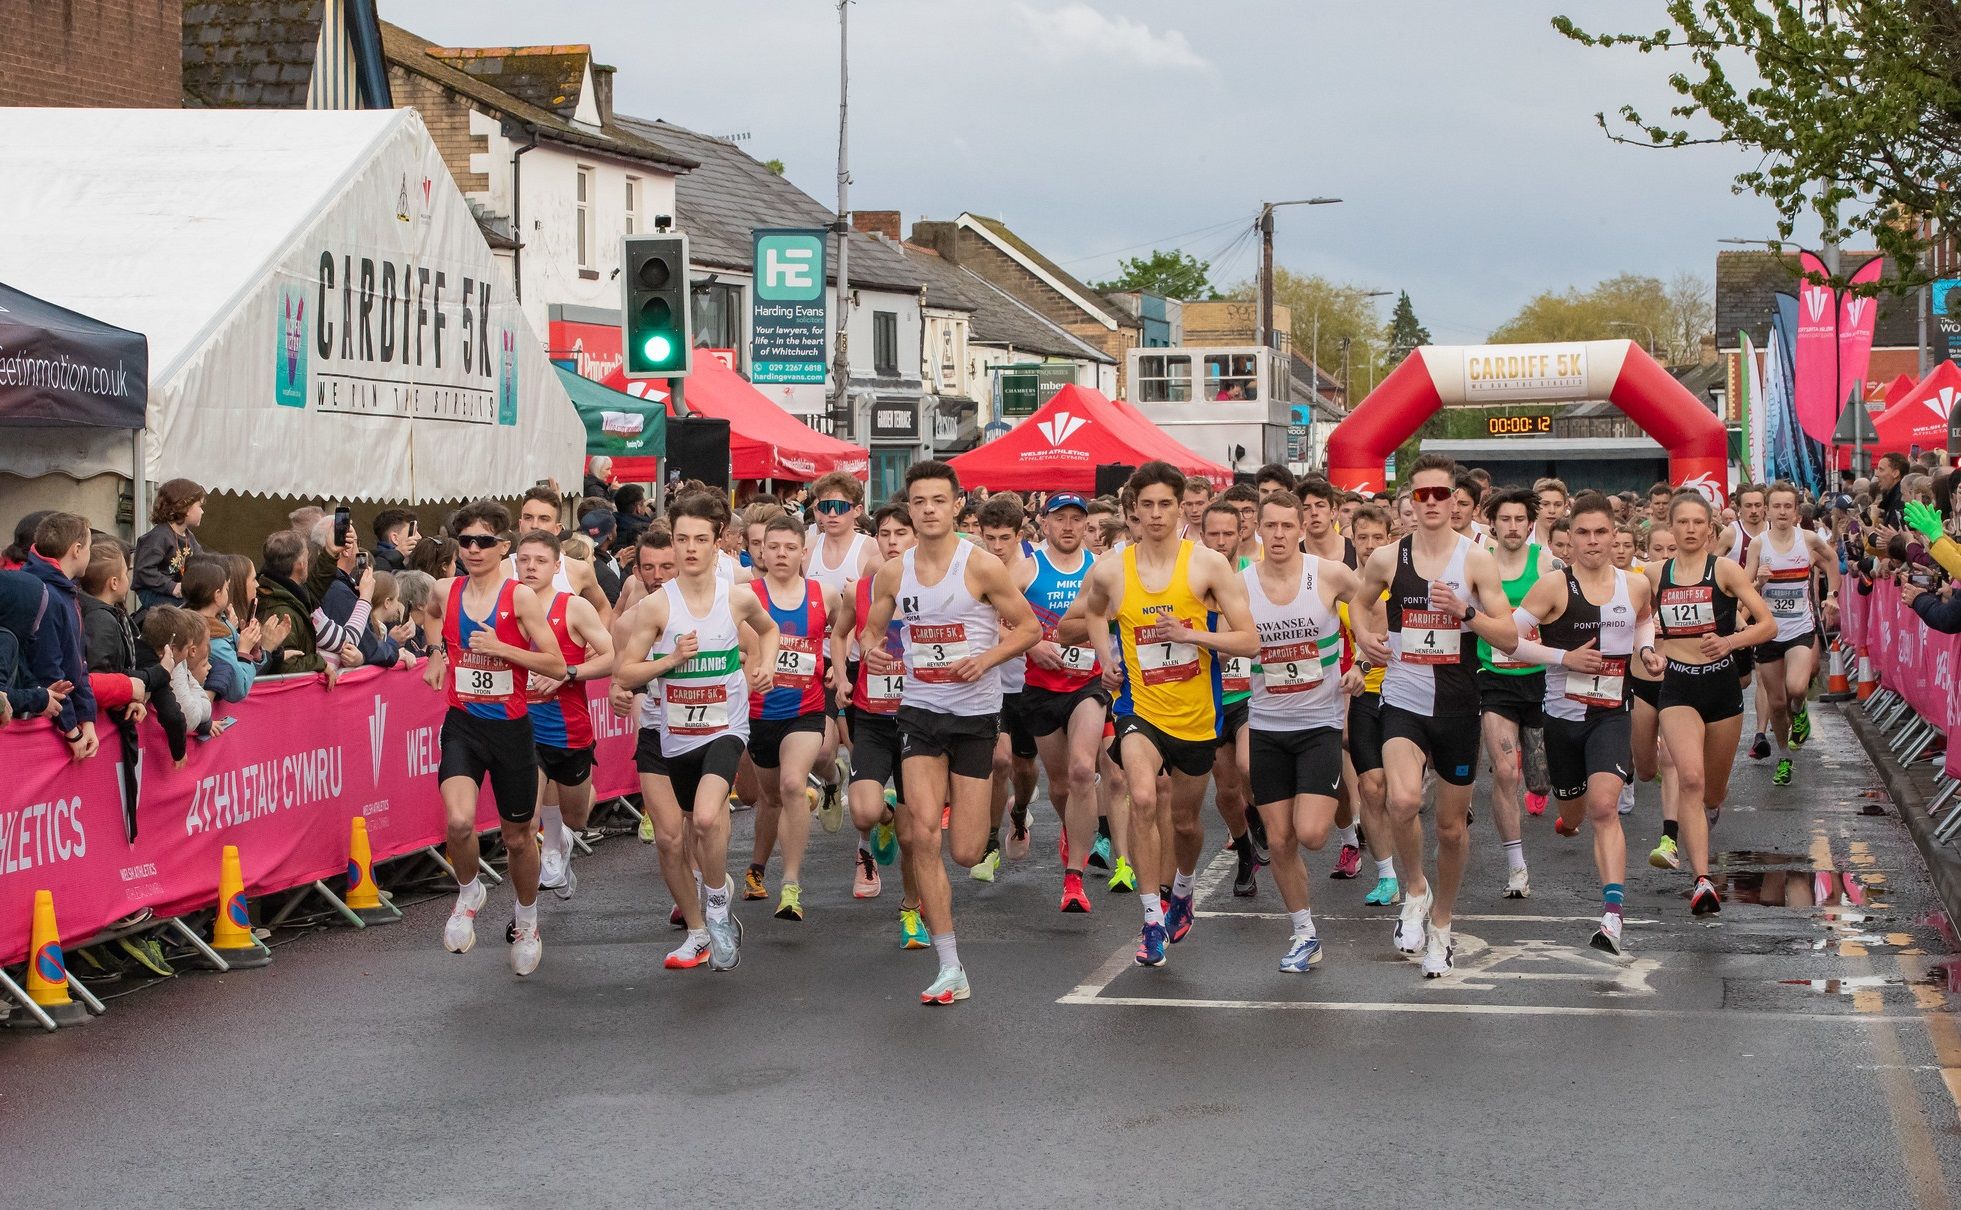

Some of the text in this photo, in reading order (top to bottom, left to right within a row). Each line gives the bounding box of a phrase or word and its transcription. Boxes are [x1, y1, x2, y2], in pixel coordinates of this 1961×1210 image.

[317, 250, 446, 369] CARDIFF
[462, 277, 492, 378] 5K
[754, 305, 824, 319] Harding Evans
[755, 326, 824, 336] Your lawyers, for
[755, 336, 769, 345] life
[776, 336, 785, 345] in
[787, 336, 800, 345] the
[802, 336, 824, 345] heart
[760, 347, 818, 356] of Whitchurch
[0, 346, 128, 397] eetinmotion.co.uk
[1469, 353, 1582, 380] CARDIFF 5K
[754, 372, 823, 382] hardingevans.com
[318, 381, 338, 406] WE
[877, 410, 893, 428] GARDEN
[1489, 416, 1551, 433] 00:00:12
[1048, 449, 1089, 457] ATHLETICS
[1569, 580, 1579, 596] soar
[1667, 588, 1705, 600] CARDIFF 5K
[1047, 591, 1064, 601] TRI
[1049, 601, 1071, 610] HAR
[1142, 605, 1174, 615] NORTH
[1774, 599, 1795, 610] 329
[906, 614, 921, 622] GYM
[1408, 612, 1453, 625] CARDIFF 5K
[1672, 604, 1700, 621] 121
[1256, 617, 1315, 633] SWANSEA
[1573, 620, 1626, 630] PONTYPRIDD
[915, 627, 957, 639] CARDIFF 5K
[1424, 630, 1436, 648] 4
[779, 636, 809, 649] RDIFF 5K
[932, 644, 945, 661] 3
[1161, 643, 1172, 660] 7
[1268, 645, 1310, 659] CARDIFF 5K
[463, 652, 504, 667] CARDIFF 5K
[778, 651, 799, 668] 43
[1669, 658, 1730, 675] NIKE PRO
[1286, 662, 1298, 679] 9
[471, 670, 494, 690] 38
[1592, 675, 1600, 692] 1
[673, 688, 718, 700] CARDIFF 5K
[684, 705, 708, 722] 77
[186, 745, 343, 836] ATHLETAU CYMRU
